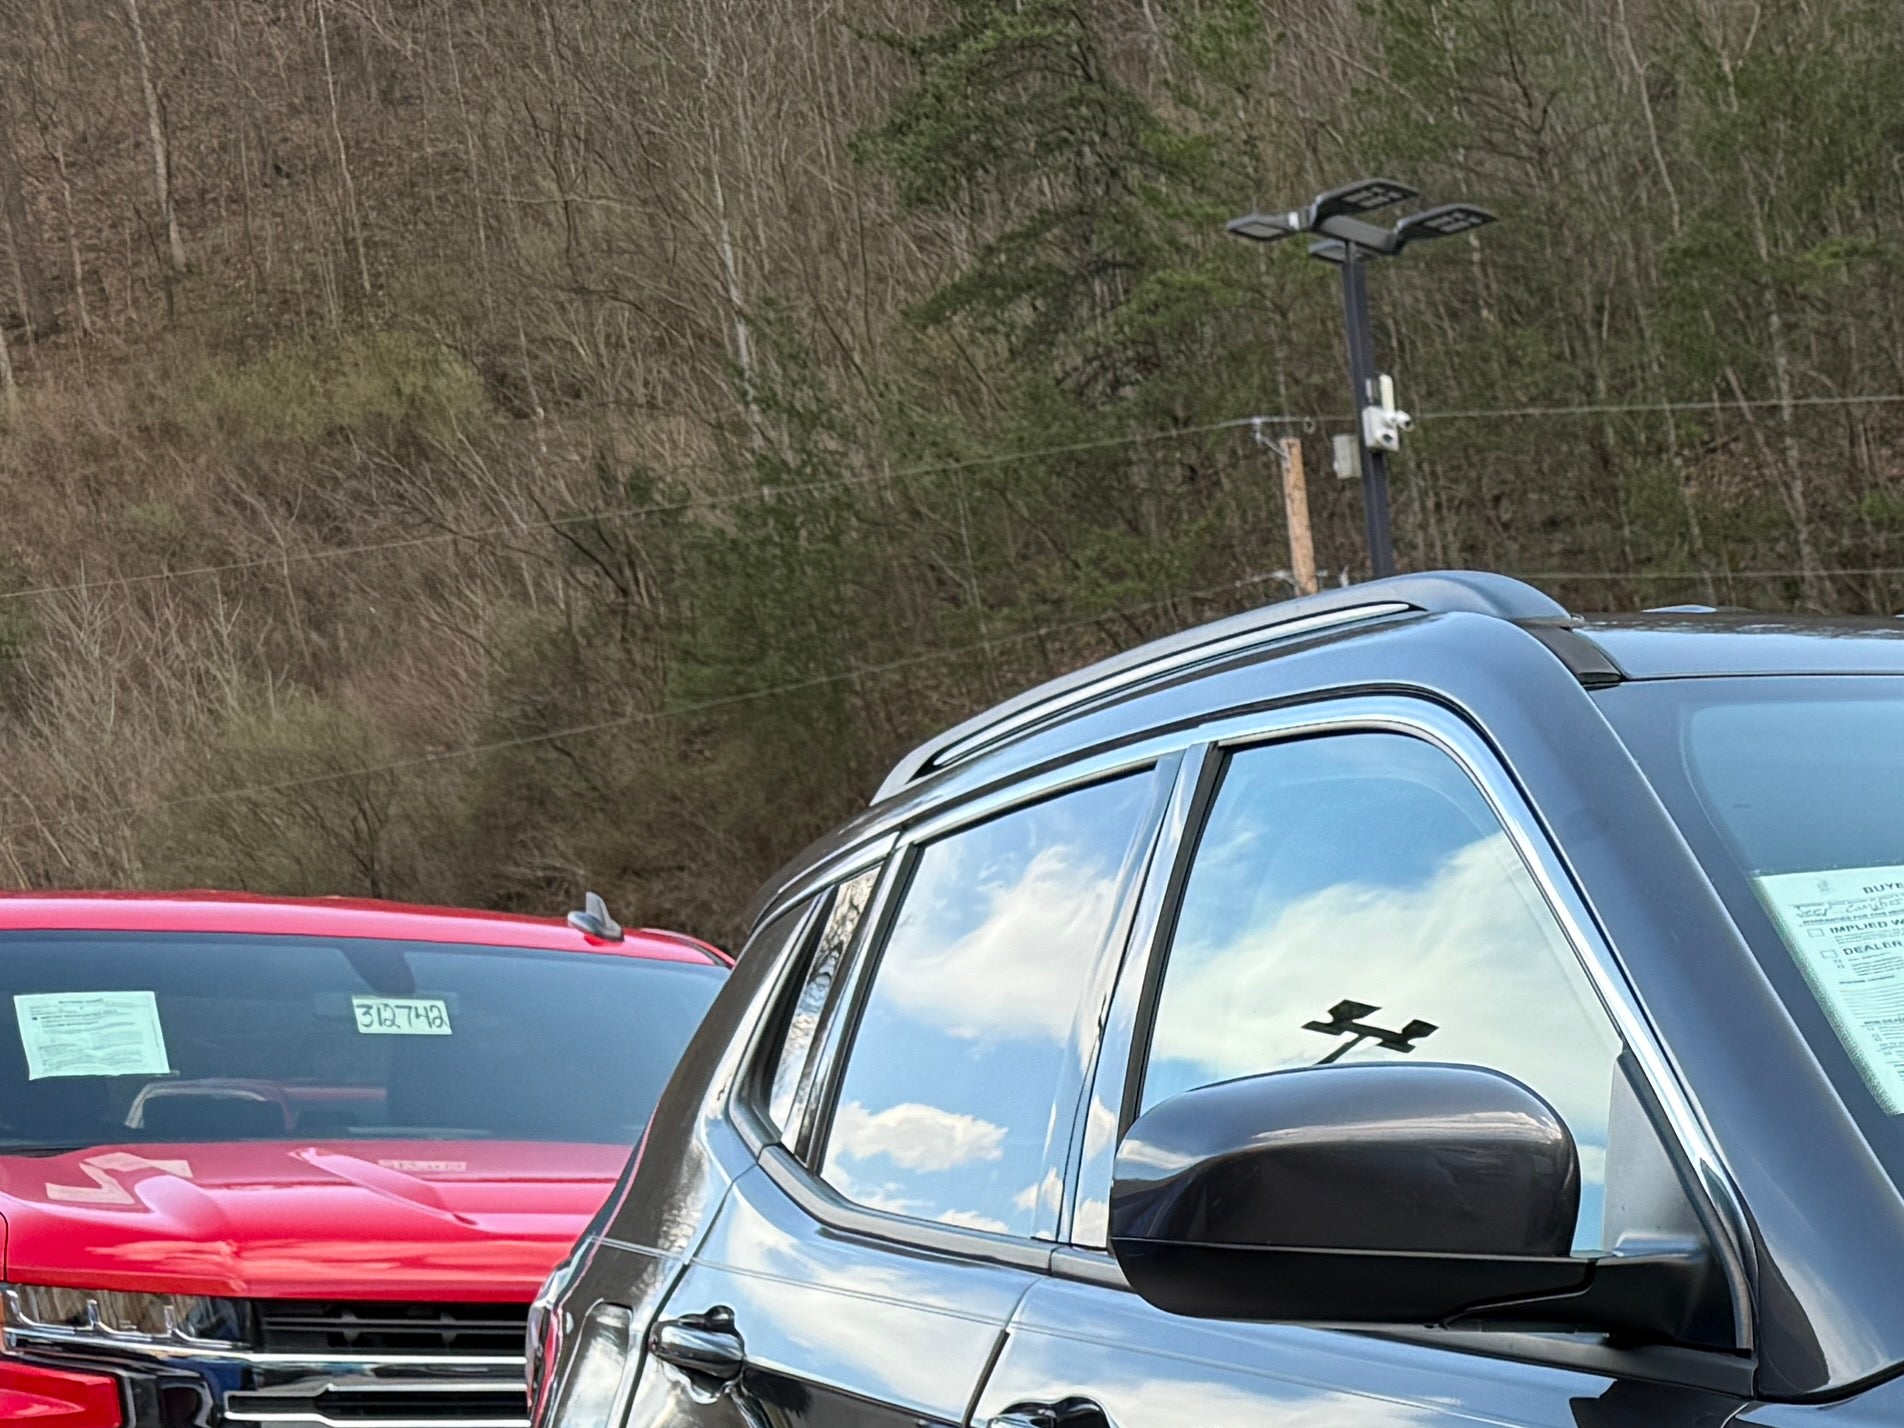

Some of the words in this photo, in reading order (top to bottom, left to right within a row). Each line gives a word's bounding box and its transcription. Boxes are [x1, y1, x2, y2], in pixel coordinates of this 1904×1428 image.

[1829, 920, 1889, 935] IMPLIED
[1842, 940, 1902, 956] DEALER
[355, 1003, 452, 1029] 312742
